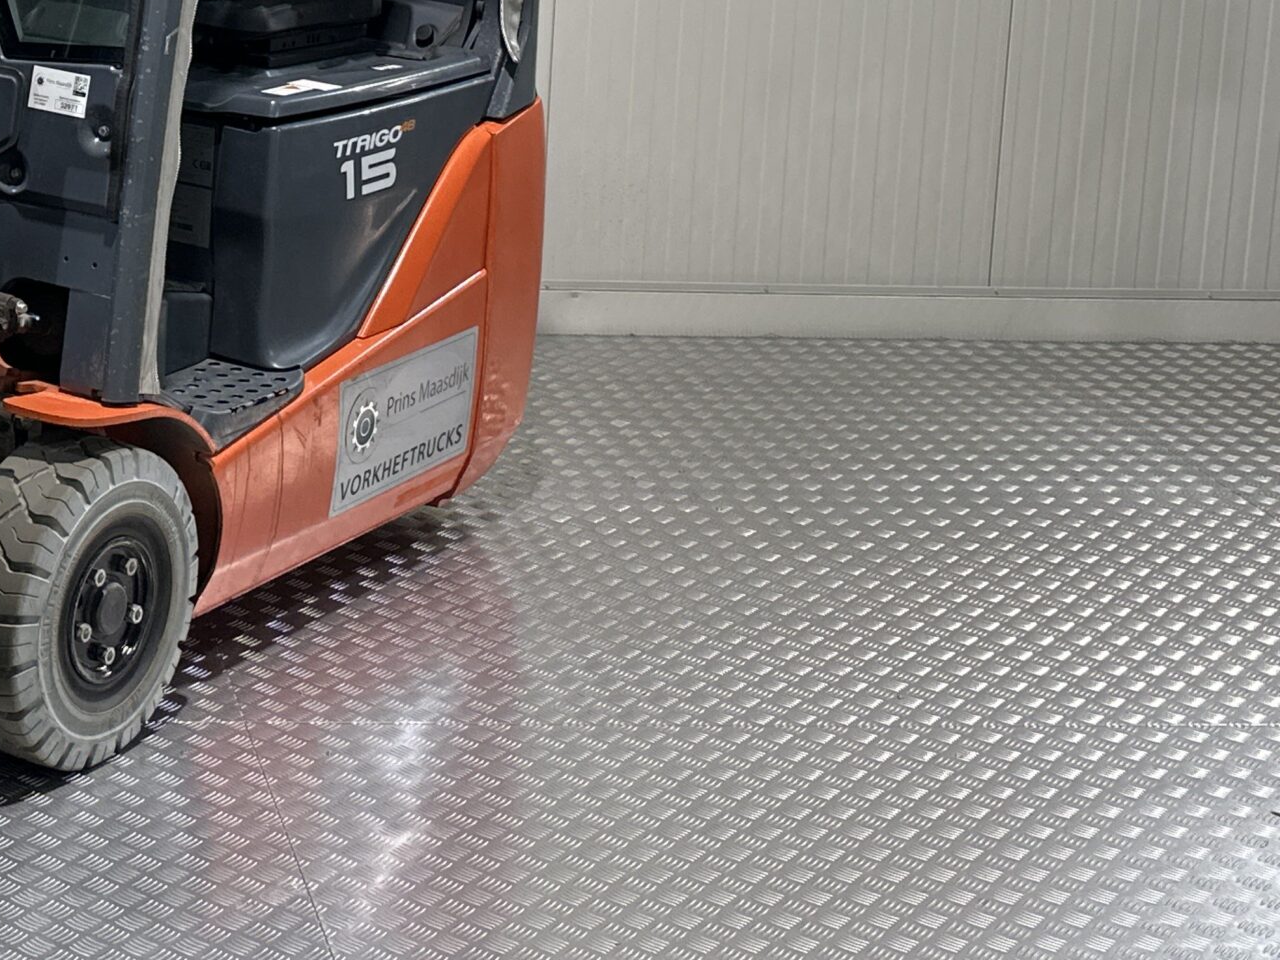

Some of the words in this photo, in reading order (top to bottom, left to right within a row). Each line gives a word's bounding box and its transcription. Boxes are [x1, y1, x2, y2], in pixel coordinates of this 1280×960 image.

[340, 147, 397, 200] 15
[385, 390, 416, 417] Prins
[418, 362, 470, 402] Maasdijk
[340, 423, 463, 501] VORKHEFTRUCKS
